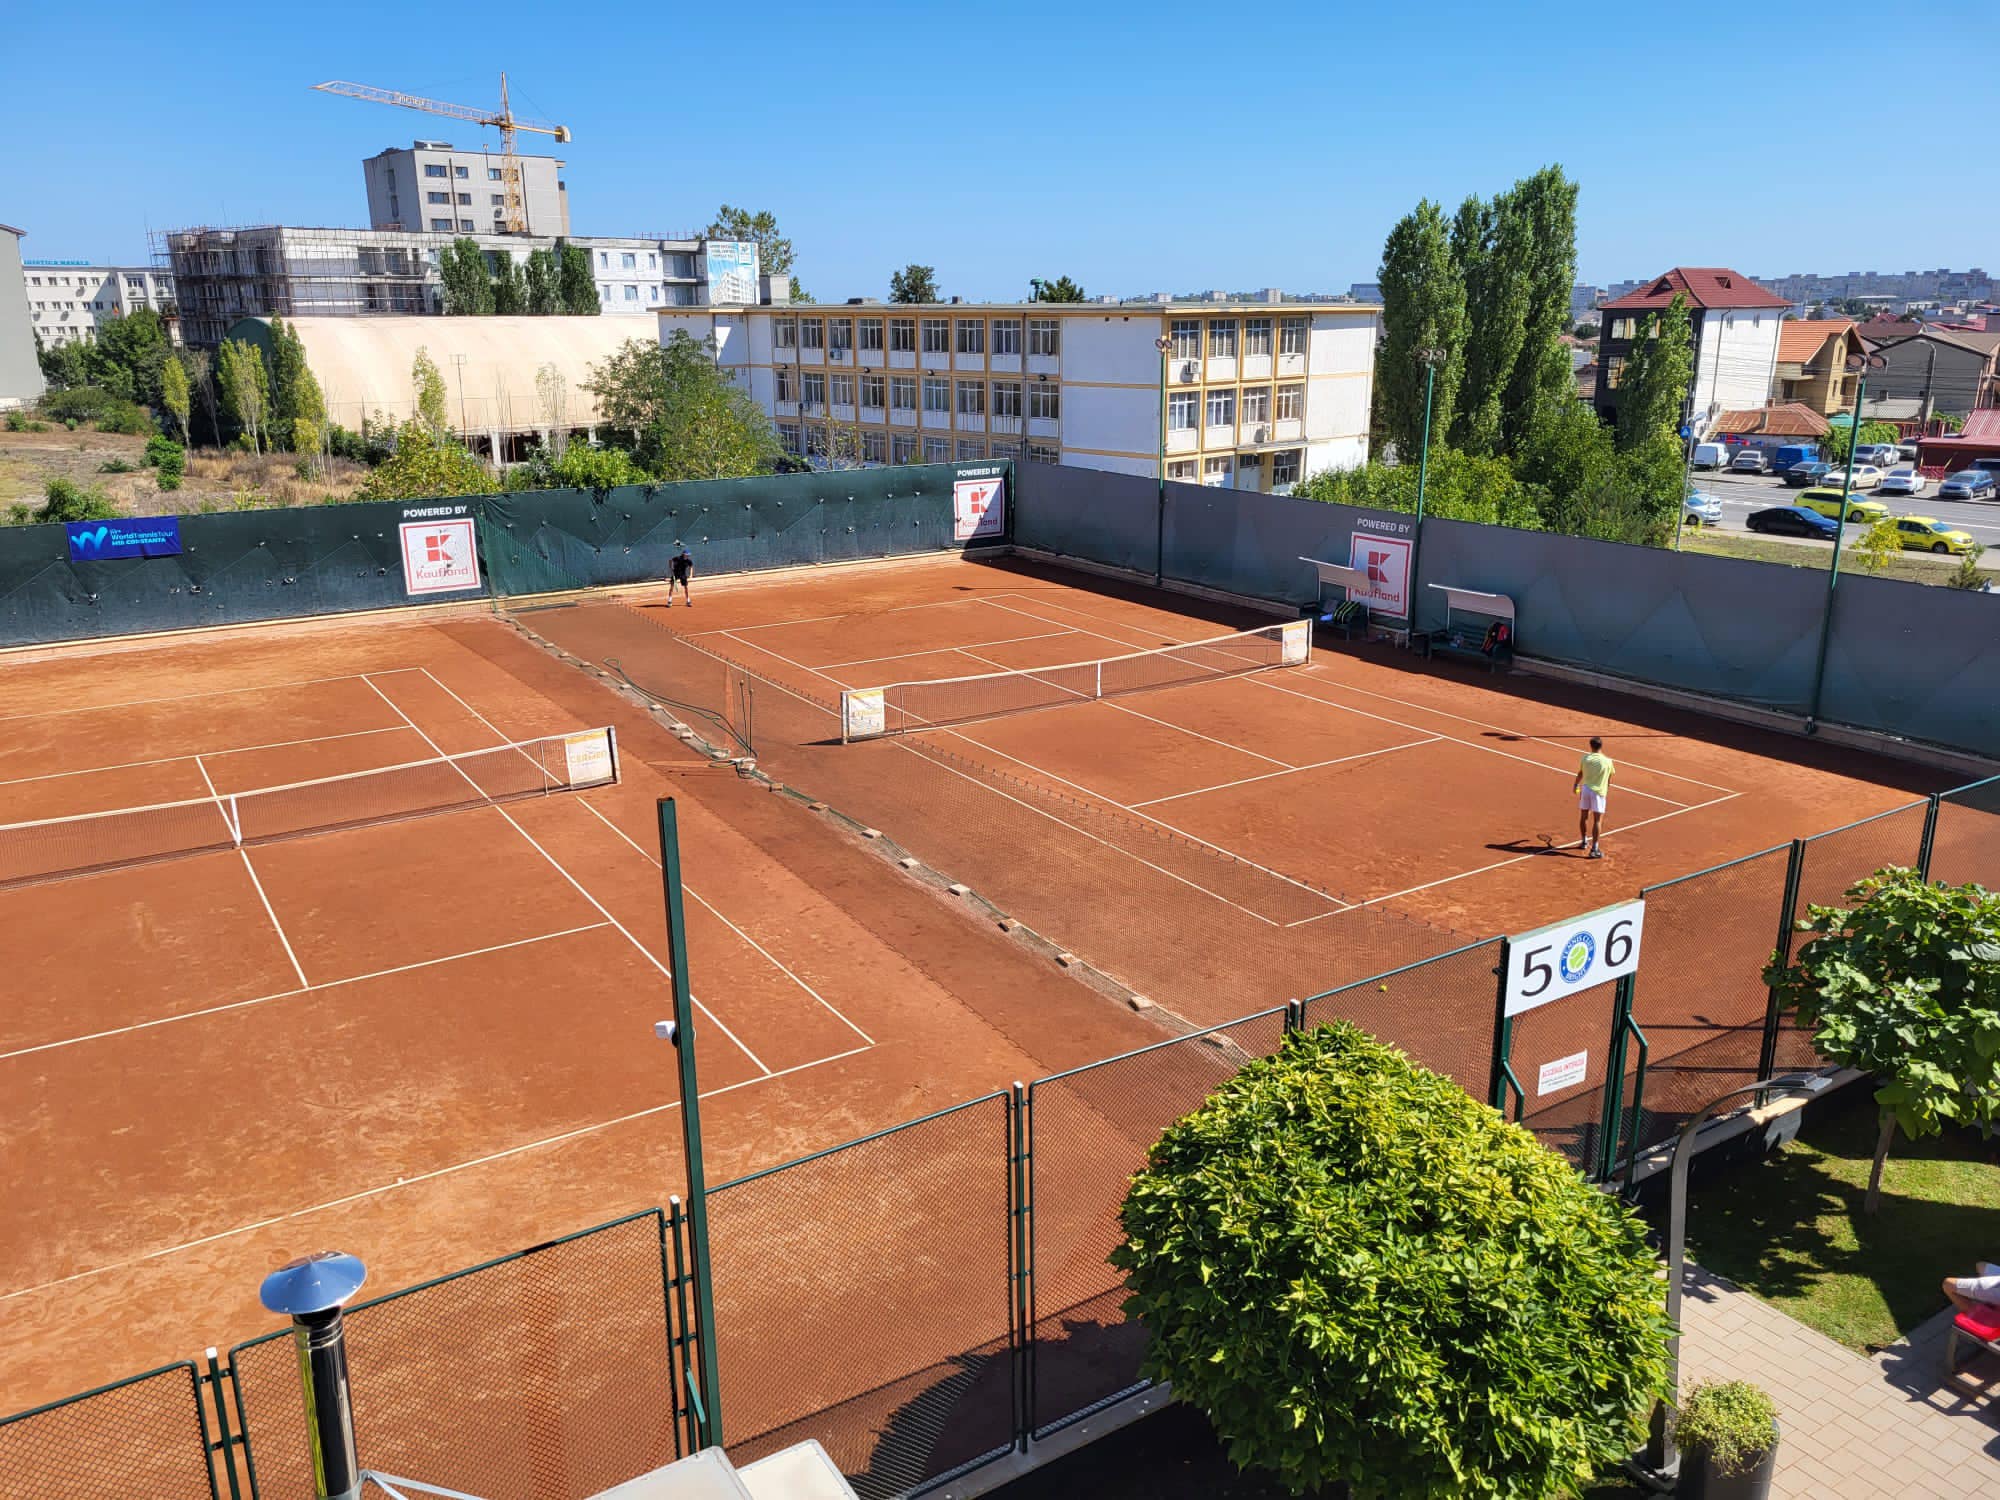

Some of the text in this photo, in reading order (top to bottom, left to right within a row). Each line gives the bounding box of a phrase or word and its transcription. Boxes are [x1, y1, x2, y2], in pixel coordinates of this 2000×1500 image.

[957, 467, 1001, 477] POWERED BY
[403, 505, 467, 518] POWERED BY
[1357, 518, 1411, 533] POWERED BY
[416, 565, 469, 580] Kaufland
[1604, 920, 1633, 967] 6
[1521, 945, 1553, 997] 5
